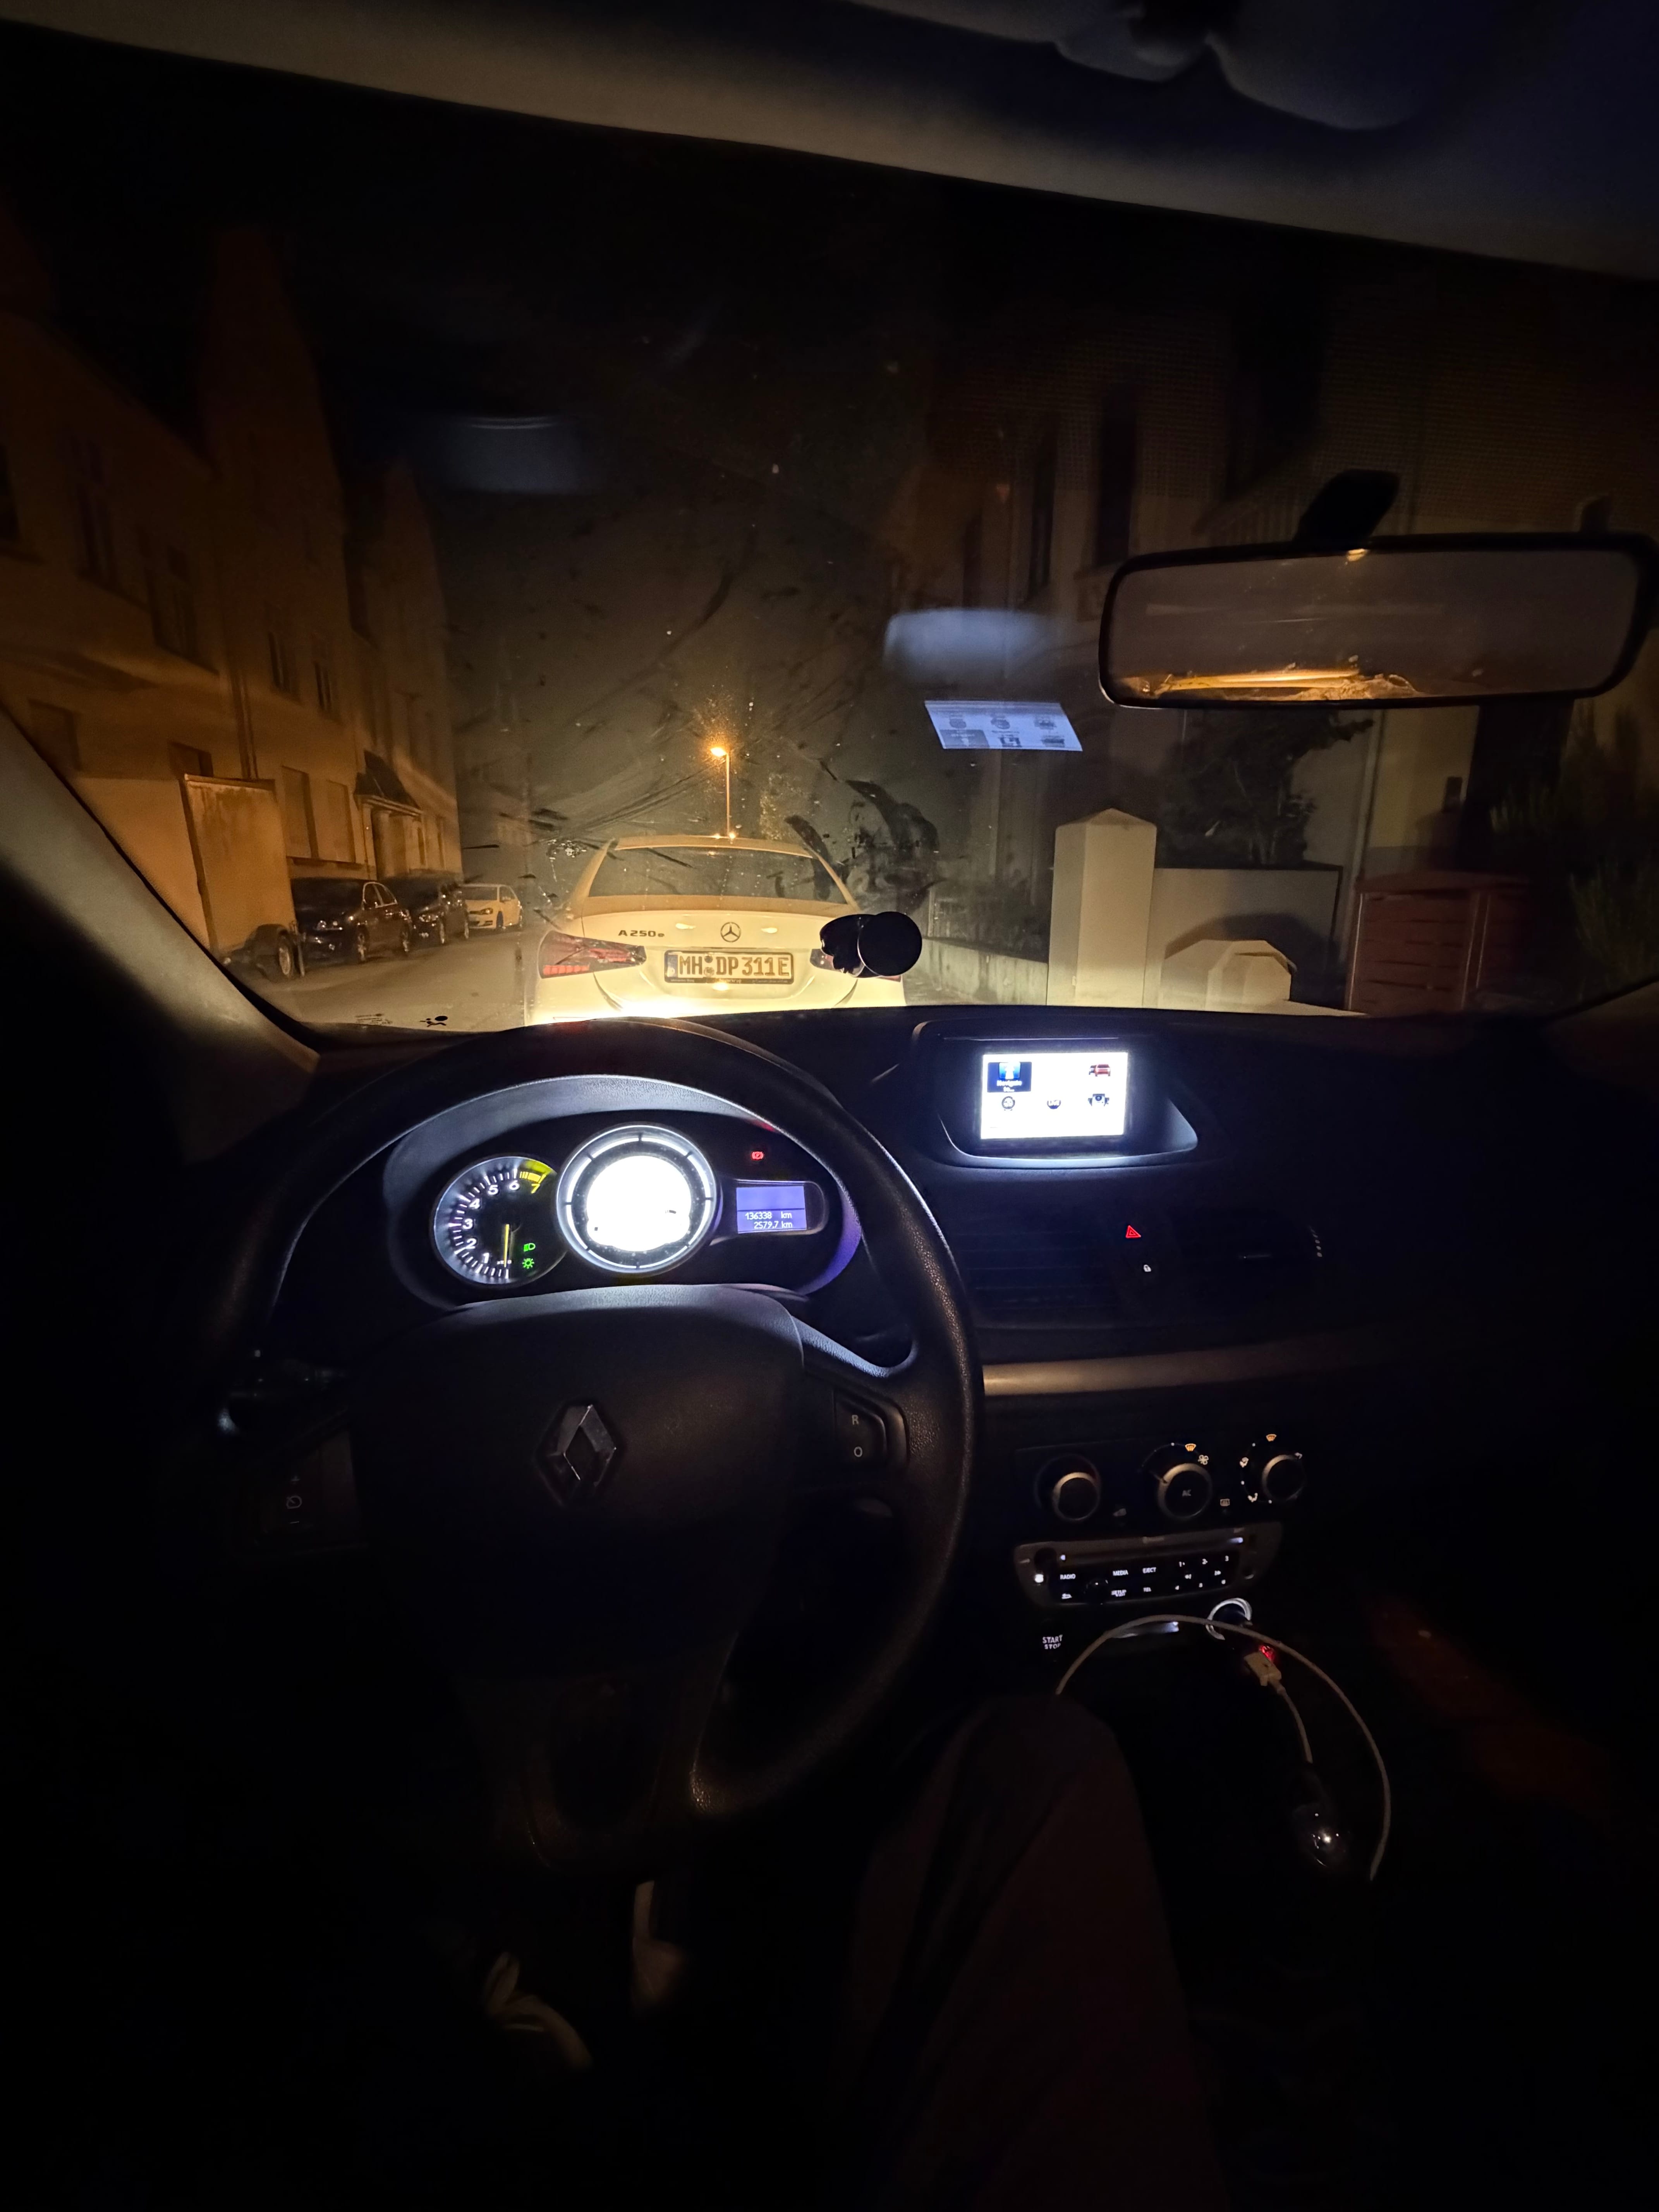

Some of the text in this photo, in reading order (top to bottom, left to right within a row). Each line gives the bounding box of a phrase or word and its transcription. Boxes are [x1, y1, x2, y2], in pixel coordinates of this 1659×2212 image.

[679, 956, 702, 975] MH
[716, 957, 739, 975] DP
[488, 1184, 499, 1195] 5
[508, 1180, 520, 1190] 6
[531, 1183, 540, 1194] 7
[469, 1199, 481, 1209] 4
[745, 1211, 772, 1220] 136338
[462, 1218, 473, 1229] 3
[754, 1221, 779, 1229] 2579.7
[465, 1238, 477, 1249] 2
[483, 1252, 489, 1264] 1
[852, 1415, 859, 1425] R
[1042, 1635, 1063, 1644] START
